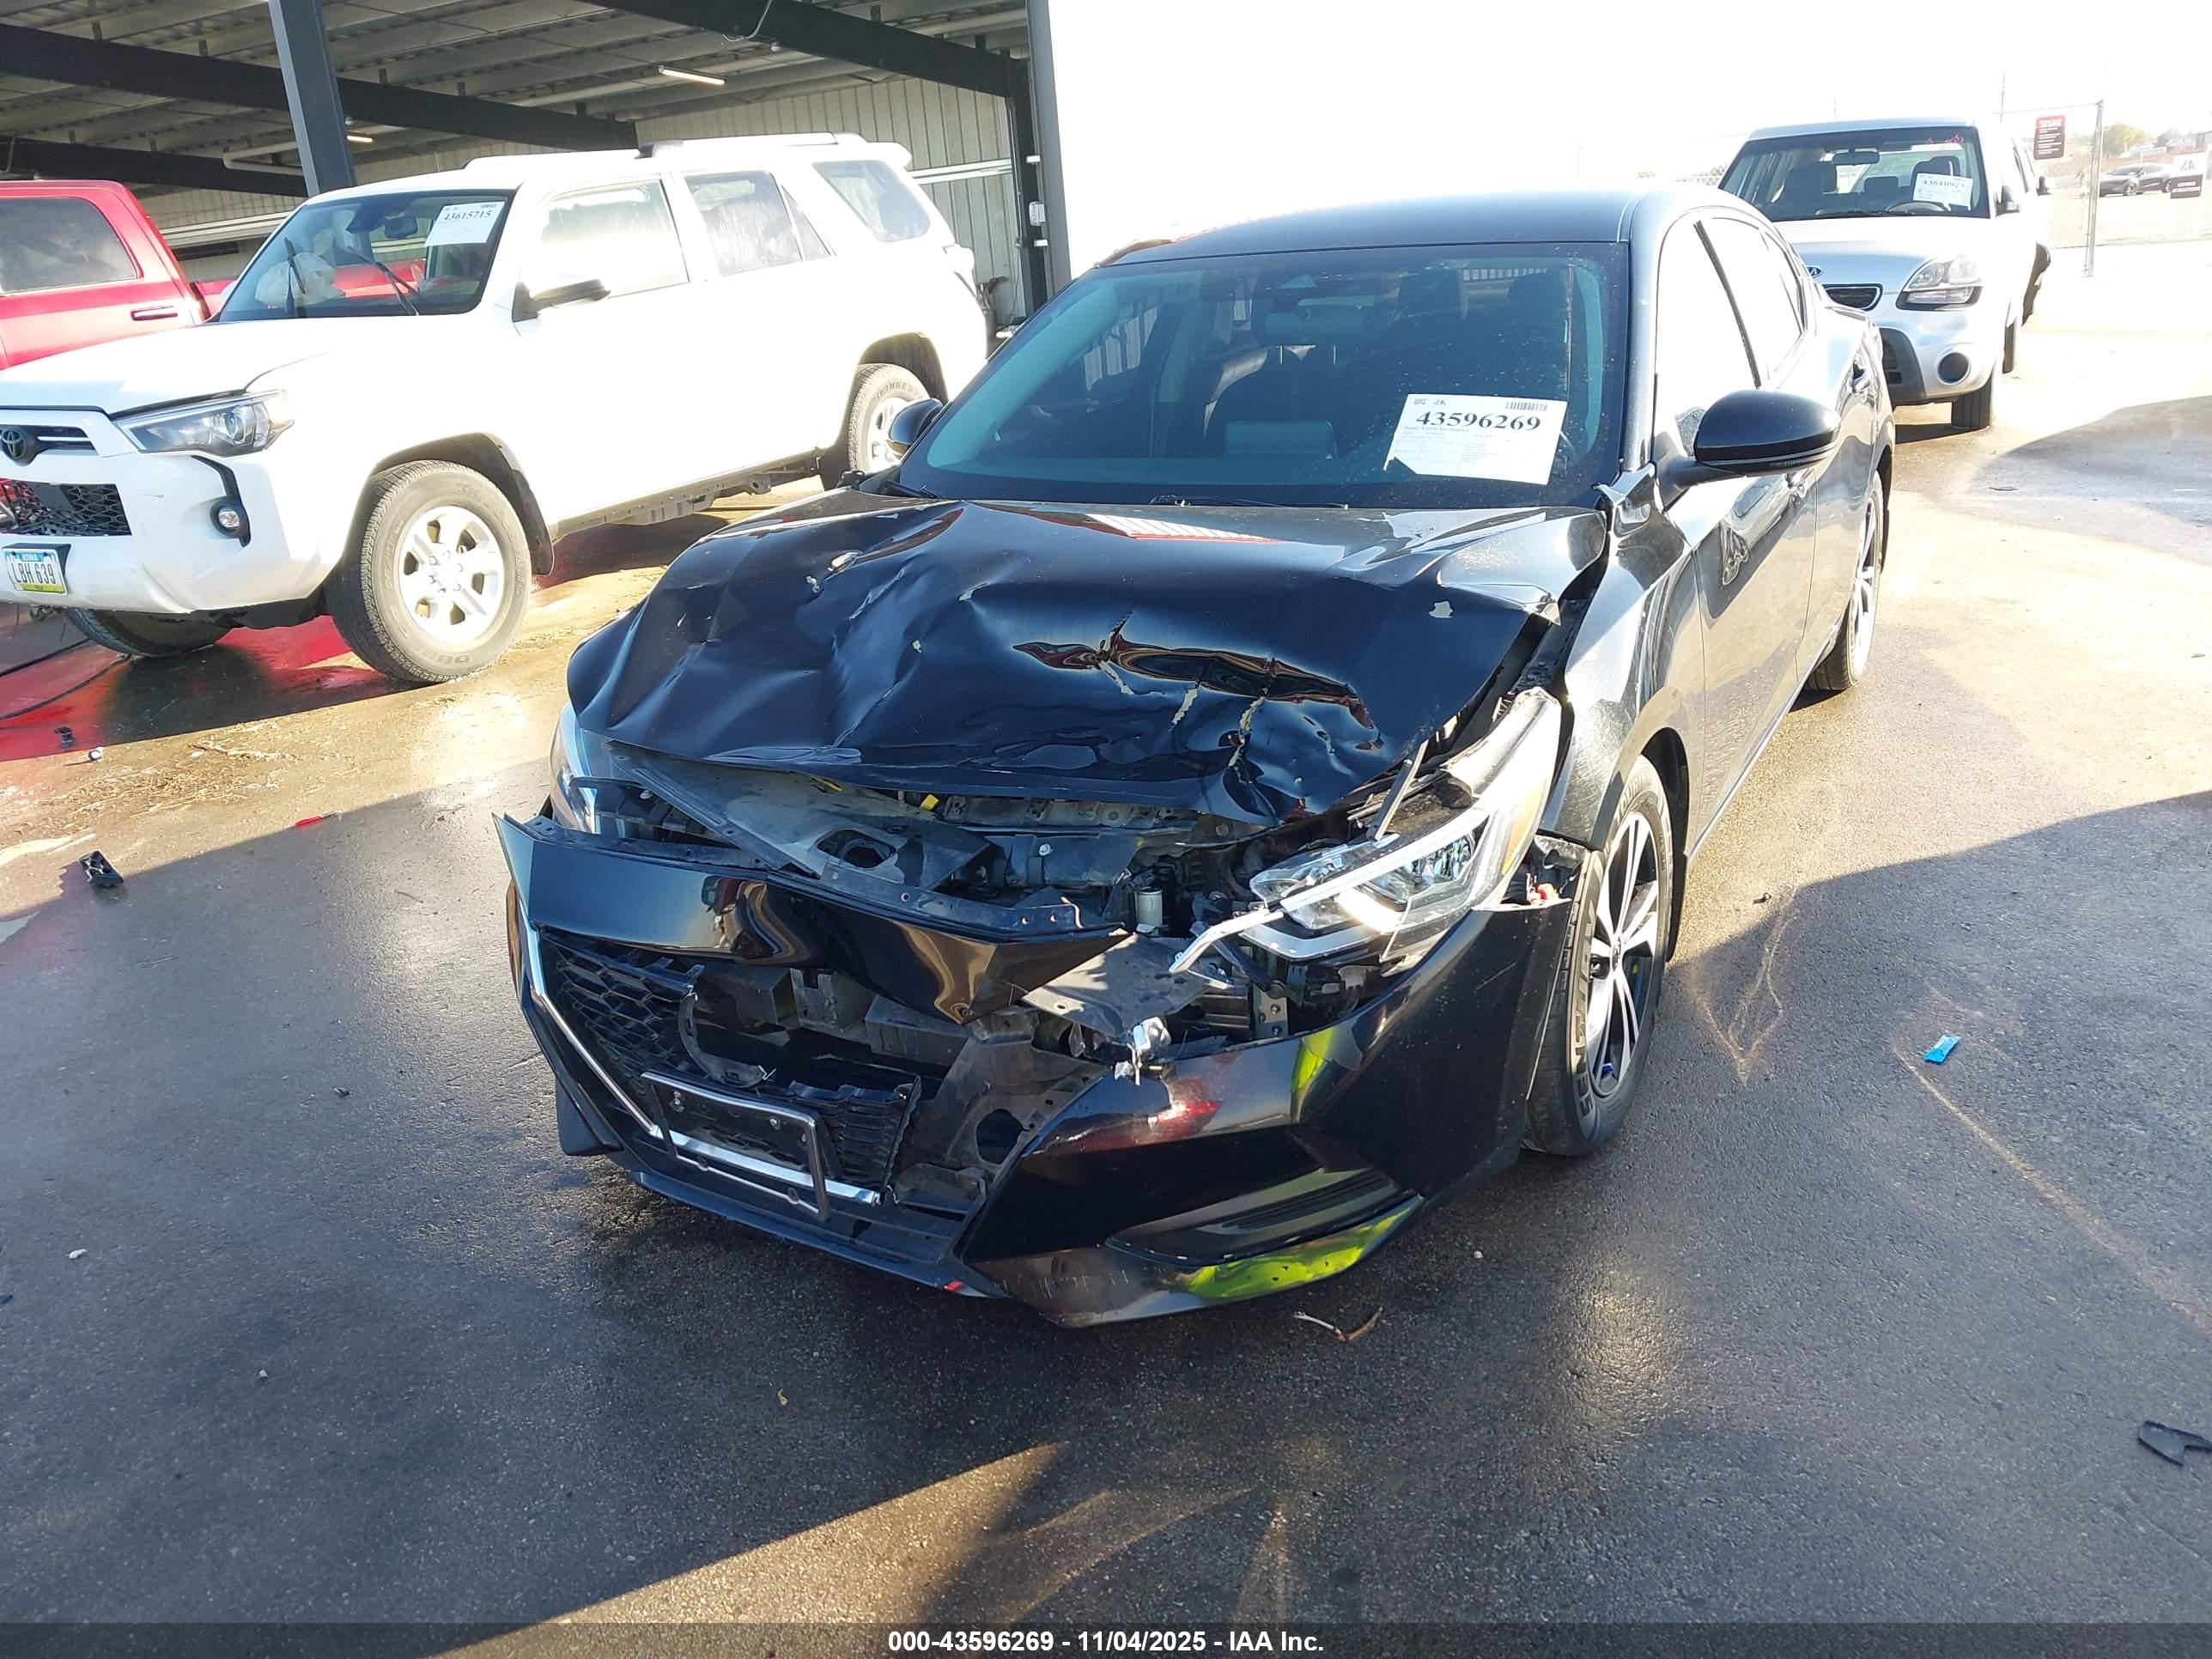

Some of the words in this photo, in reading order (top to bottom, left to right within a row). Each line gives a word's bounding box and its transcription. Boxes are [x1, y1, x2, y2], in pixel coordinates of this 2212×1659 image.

[1416, 410, 1541, 431] 43596269
[10, 562, 35, 584] LBH
[33, 562, 56, 585] 639
